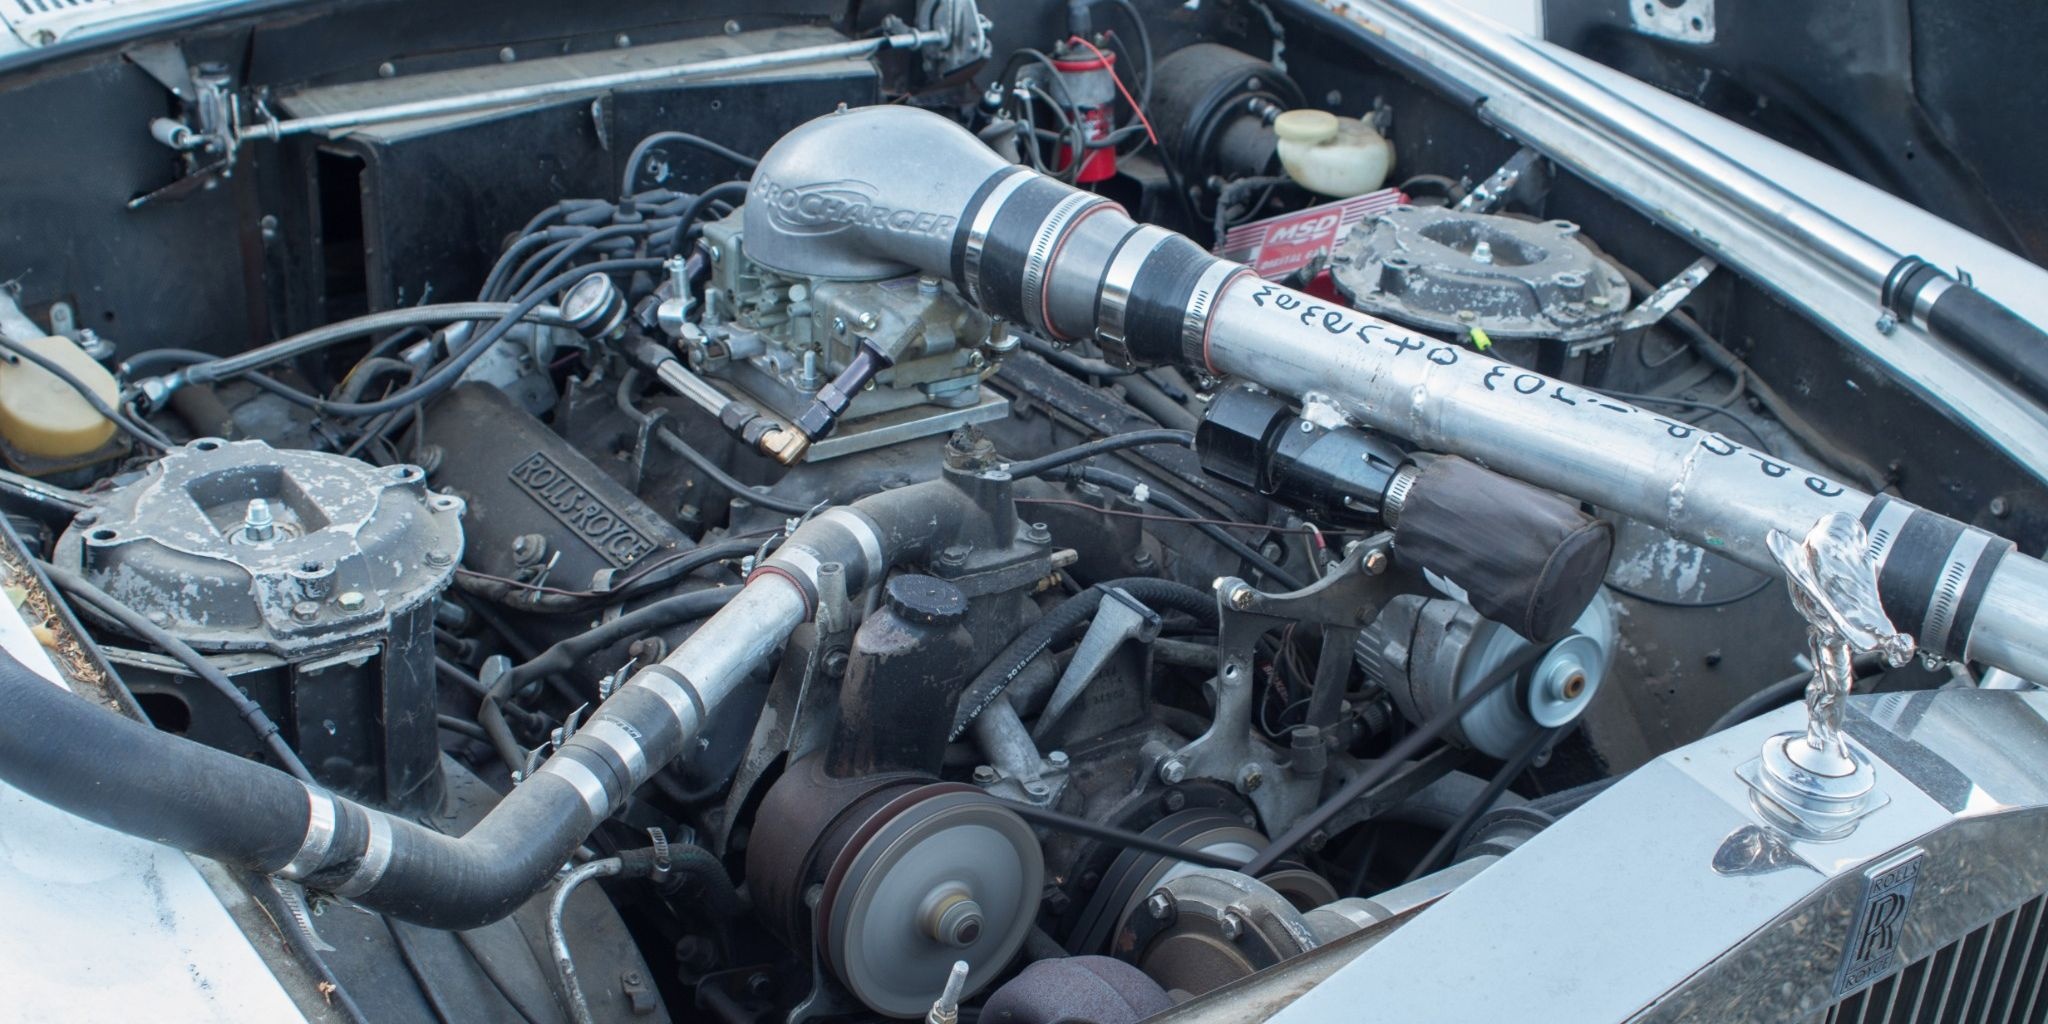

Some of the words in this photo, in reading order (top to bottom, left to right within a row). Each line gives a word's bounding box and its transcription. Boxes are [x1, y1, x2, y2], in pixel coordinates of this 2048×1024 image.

[752, 172, 957, 240] PROCHARGER
[1268, 214, 1339, 246] MSD
[514, 455, 650, 566] ROLLS-ROYCE
[1873, 860, 1919, 894] ROLLS
[1844, 959, 1891, 990] ROYCE
